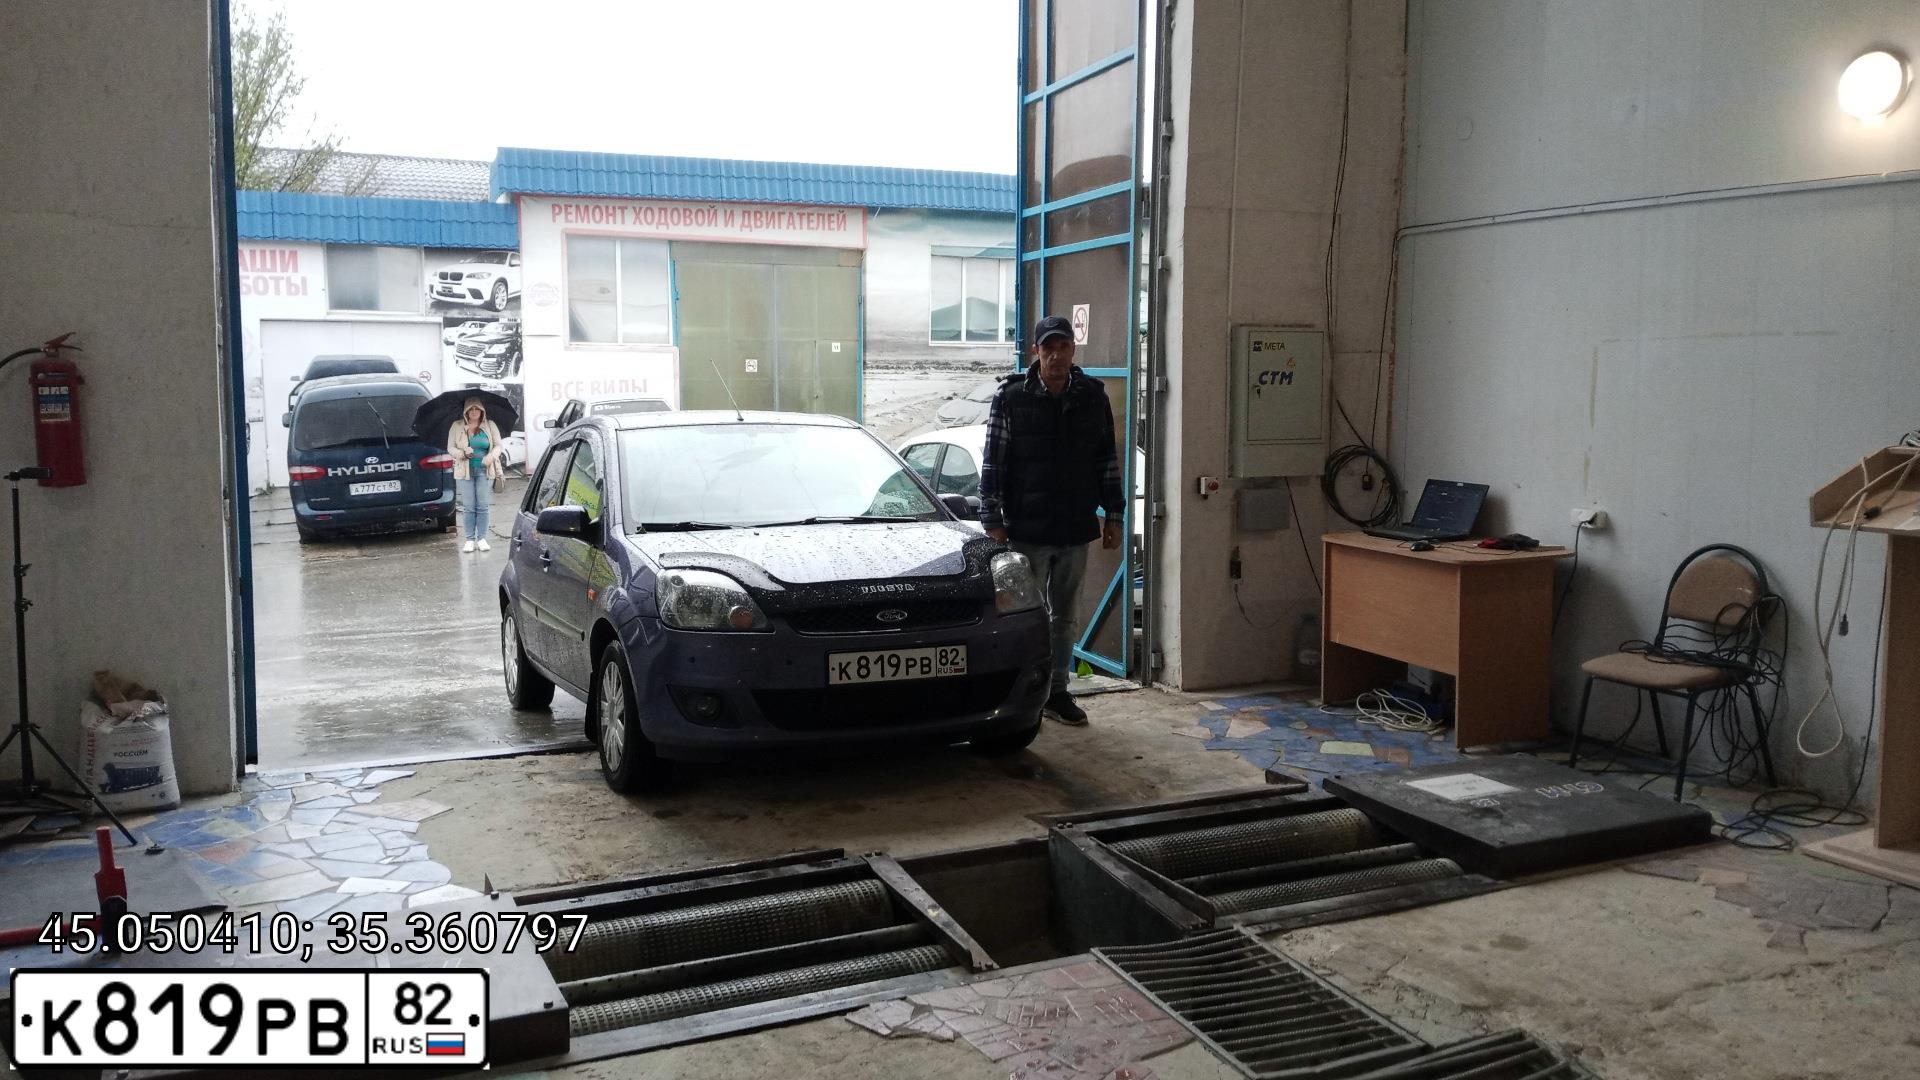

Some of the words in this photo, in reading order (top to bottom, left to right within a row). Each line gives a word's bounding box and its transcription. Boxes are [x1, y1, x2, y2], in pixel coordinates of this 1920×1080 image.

[551, 203, 627, 225] РЕМОНТ
[632, 205, 718, 229] ХОДОВОЙ
[723, 211, 734, 227] И
[740, 209, 848, 231] ДВИГАТЕЛЕЙ
[1258, 370, 1294, 386] СТМ
[327, 461, 412, 477] HYUNDAI
[861, 583, 915, 594] FIESTA
[838, 653, 932, 681] К819РВ
[938, 648, 960, 666] 82
